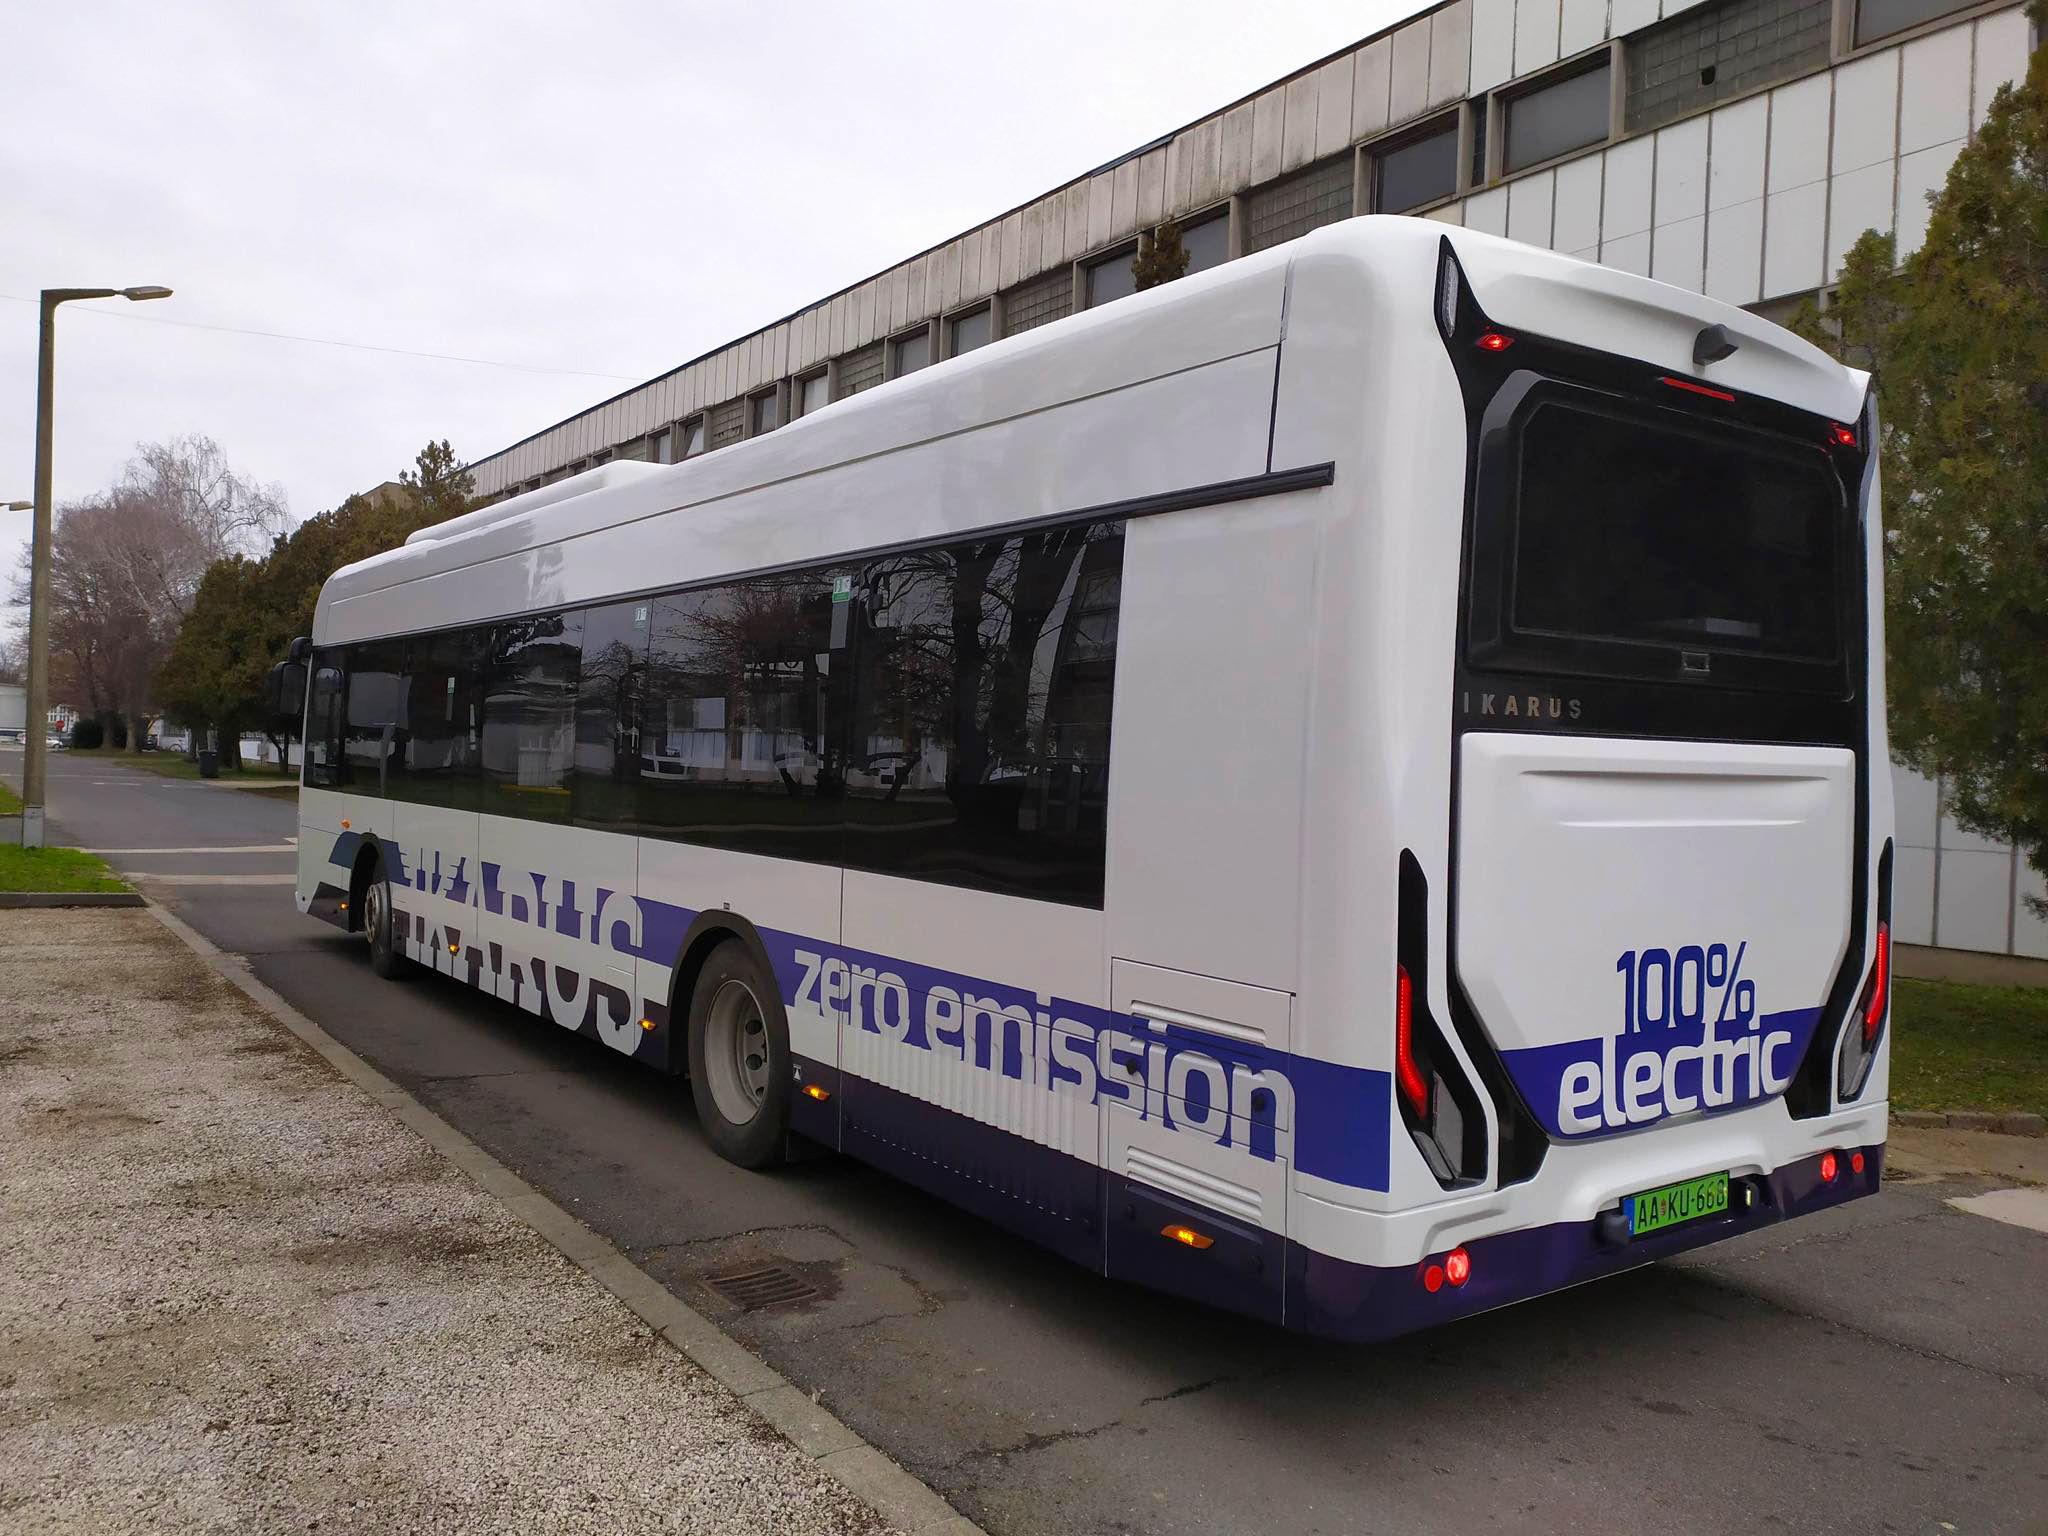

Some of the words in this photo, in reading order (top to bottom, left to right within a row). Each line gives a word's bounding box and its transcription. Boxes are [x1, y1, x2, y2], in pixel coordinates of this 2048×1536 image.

[1463, 692, 1582, 719] IKARUS
[1617, 941, 1756, 1033] 100%
[794, 949, 910, 1043] zero
[925, 985, 1297, 1161] emission
[1558, 1019, 1792, 1135] electric
